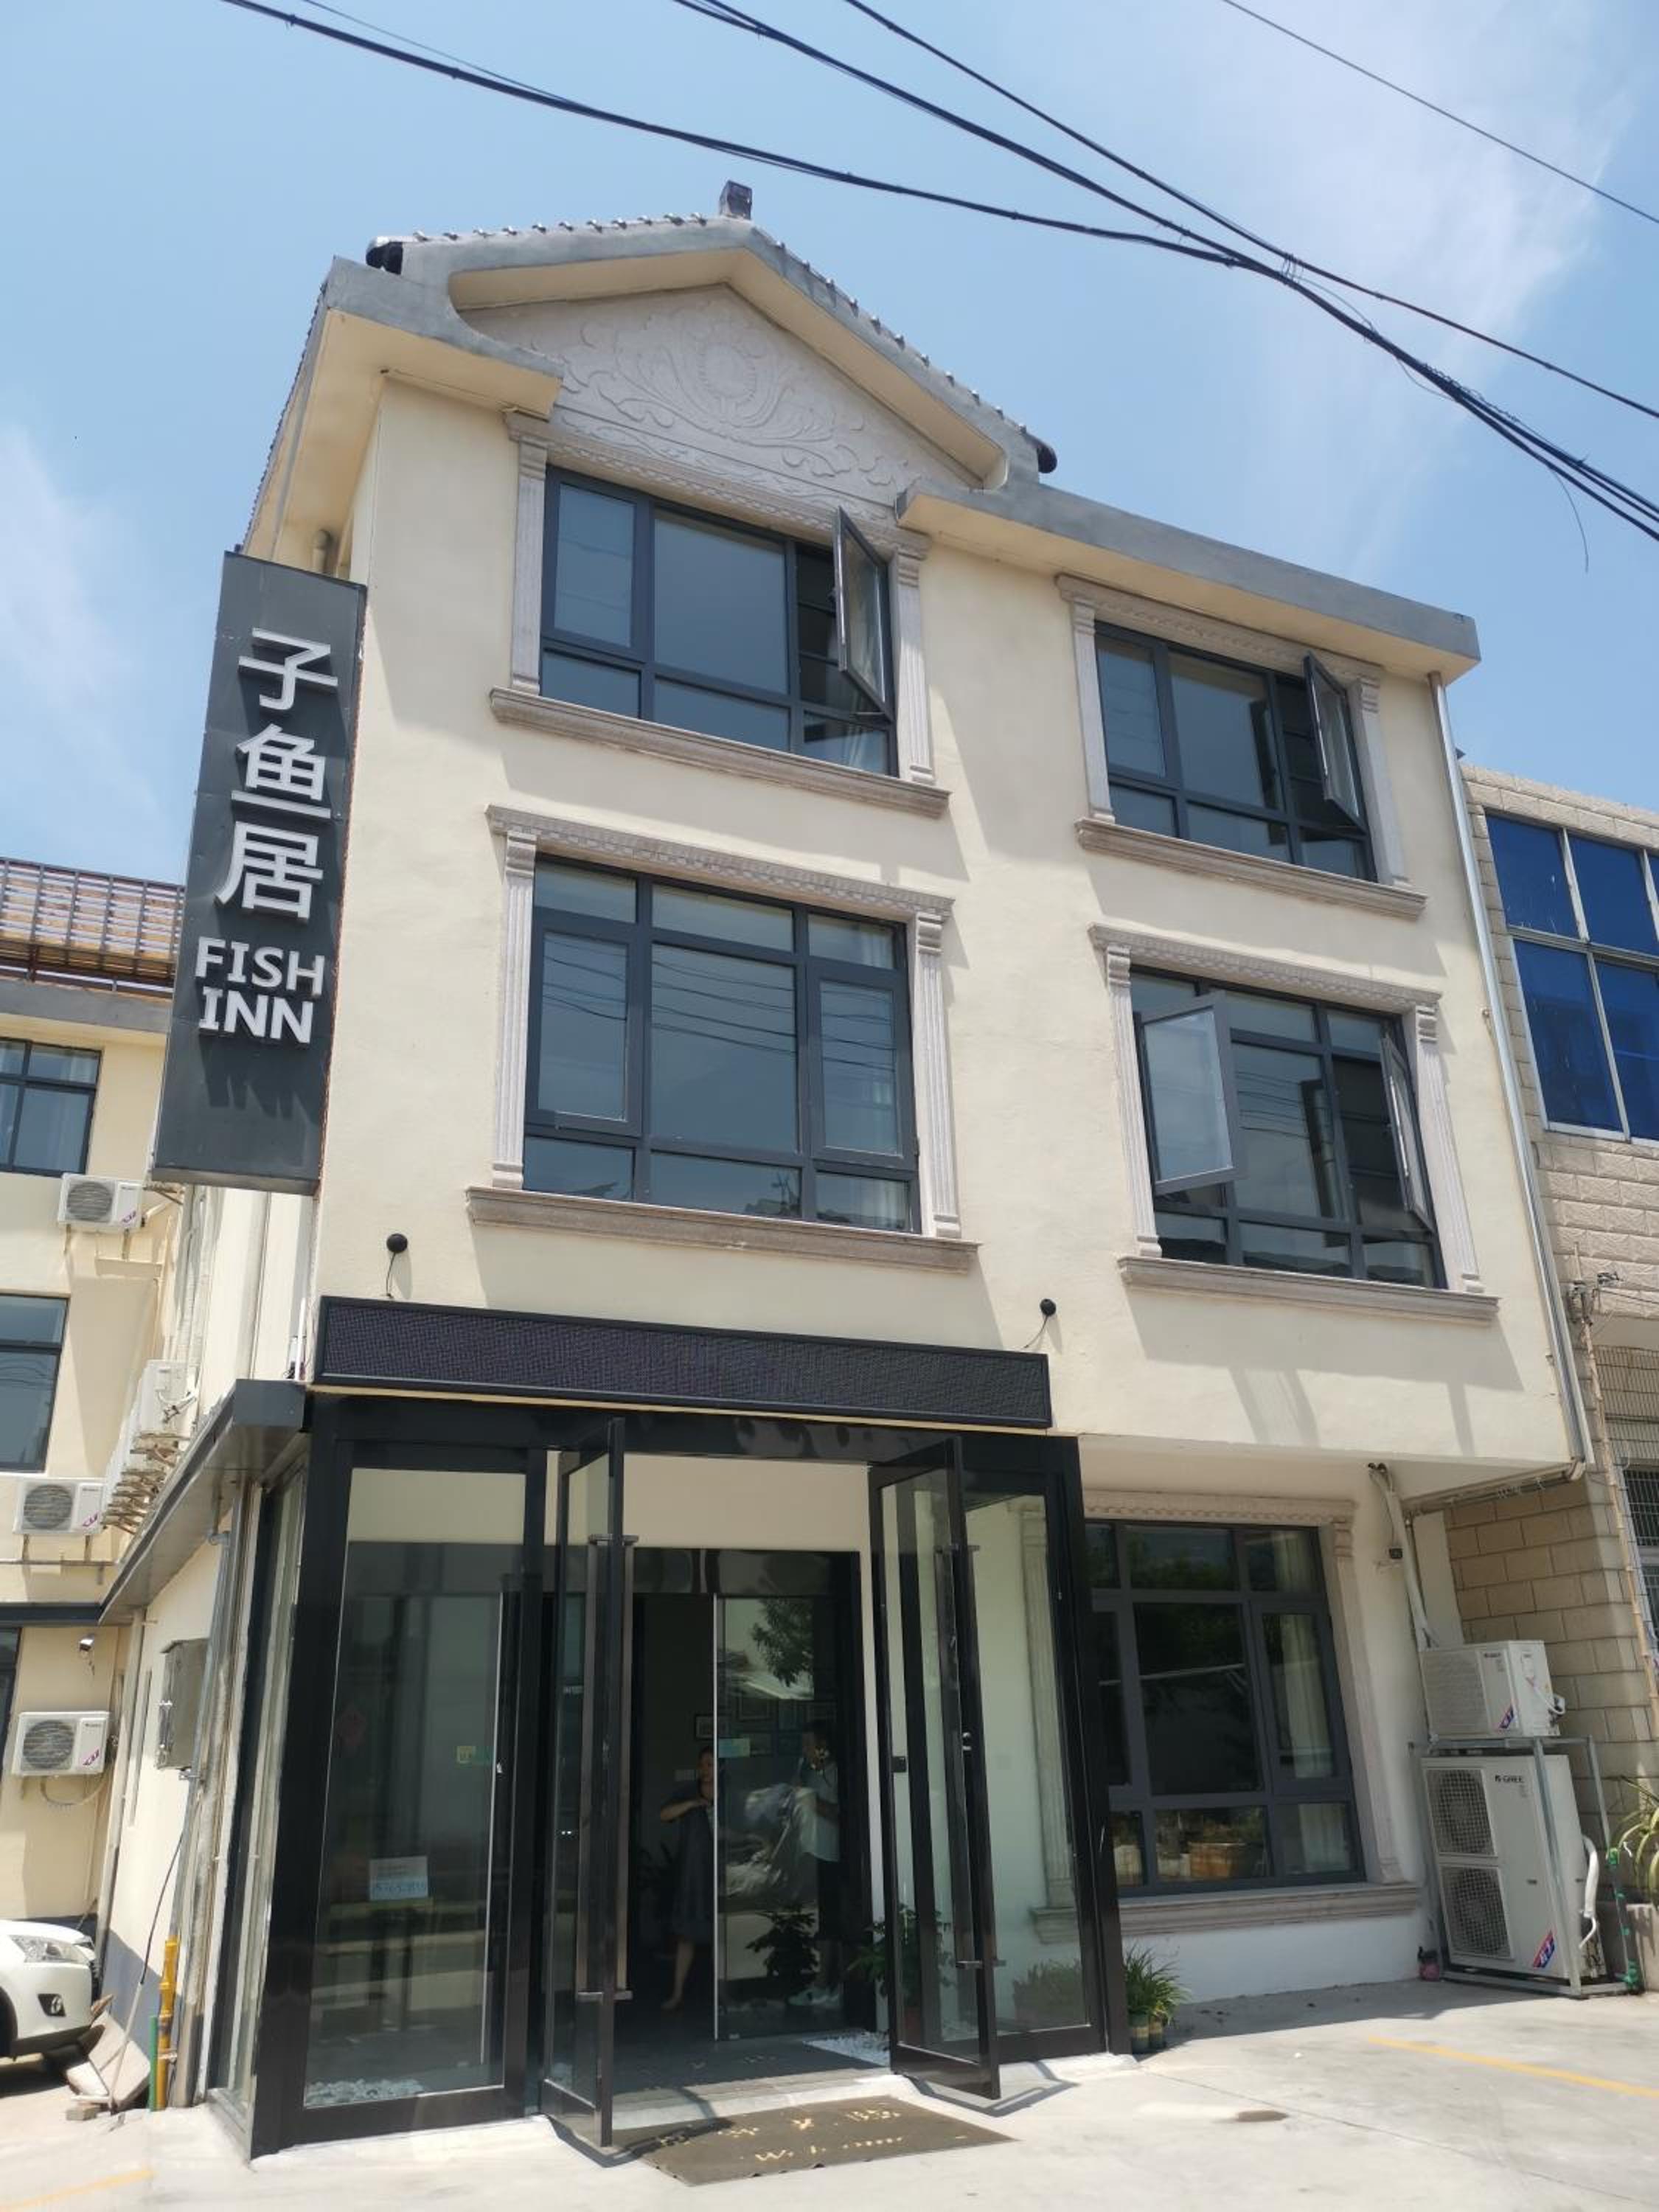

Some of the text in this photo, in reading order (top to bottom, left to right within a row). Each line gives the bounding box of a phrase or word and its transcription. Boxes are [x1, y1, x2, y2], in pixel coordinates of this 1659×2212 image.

[214, 627, 338, 920] 子鱼居
[195, 936, 325, 997] FISH
[198, 986, 313, 1044] INN
